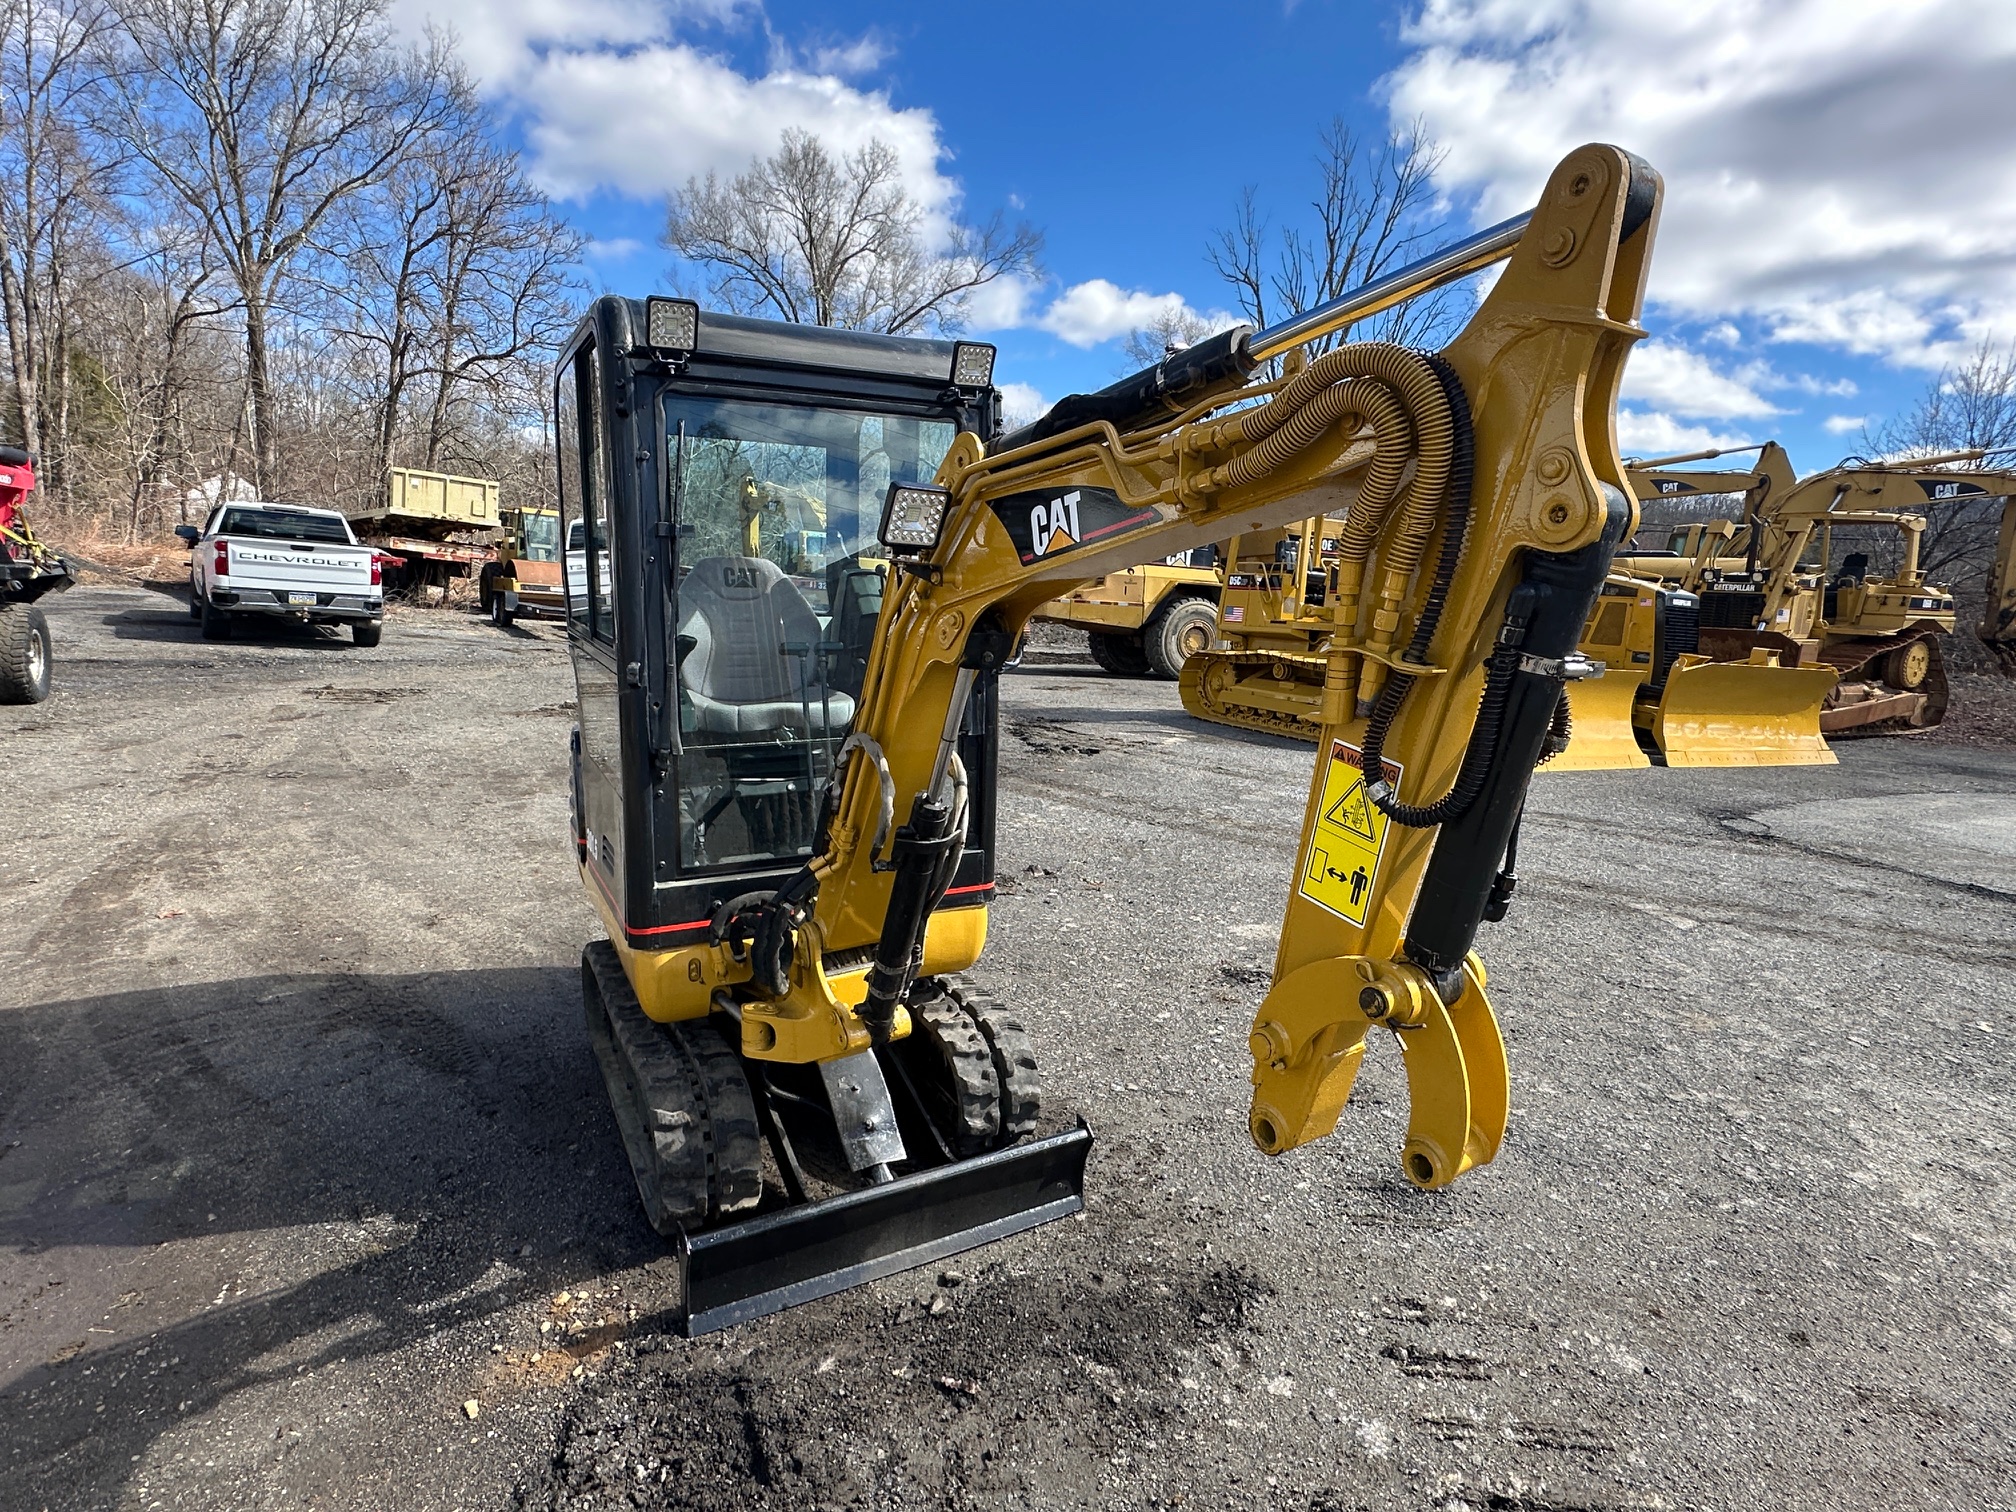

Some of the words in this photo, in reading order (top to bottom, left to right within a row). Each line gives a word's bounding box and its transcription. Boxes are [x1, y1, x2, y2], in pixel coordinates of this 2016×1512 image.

[1663, 482, 1678, 493] CAT
[1935, 483, 1959, 498] CAT
[1031, 490, 1081, 556] CAT
[239, 552, 363, 567] CHEVROLET
[1166, 548, 1194, 568] CAT
[723, 566, 757, 588] CAT
[1713, 583, 1756, 591] CATERPILLAR
[1346, 752, 1397, 781] WANG
